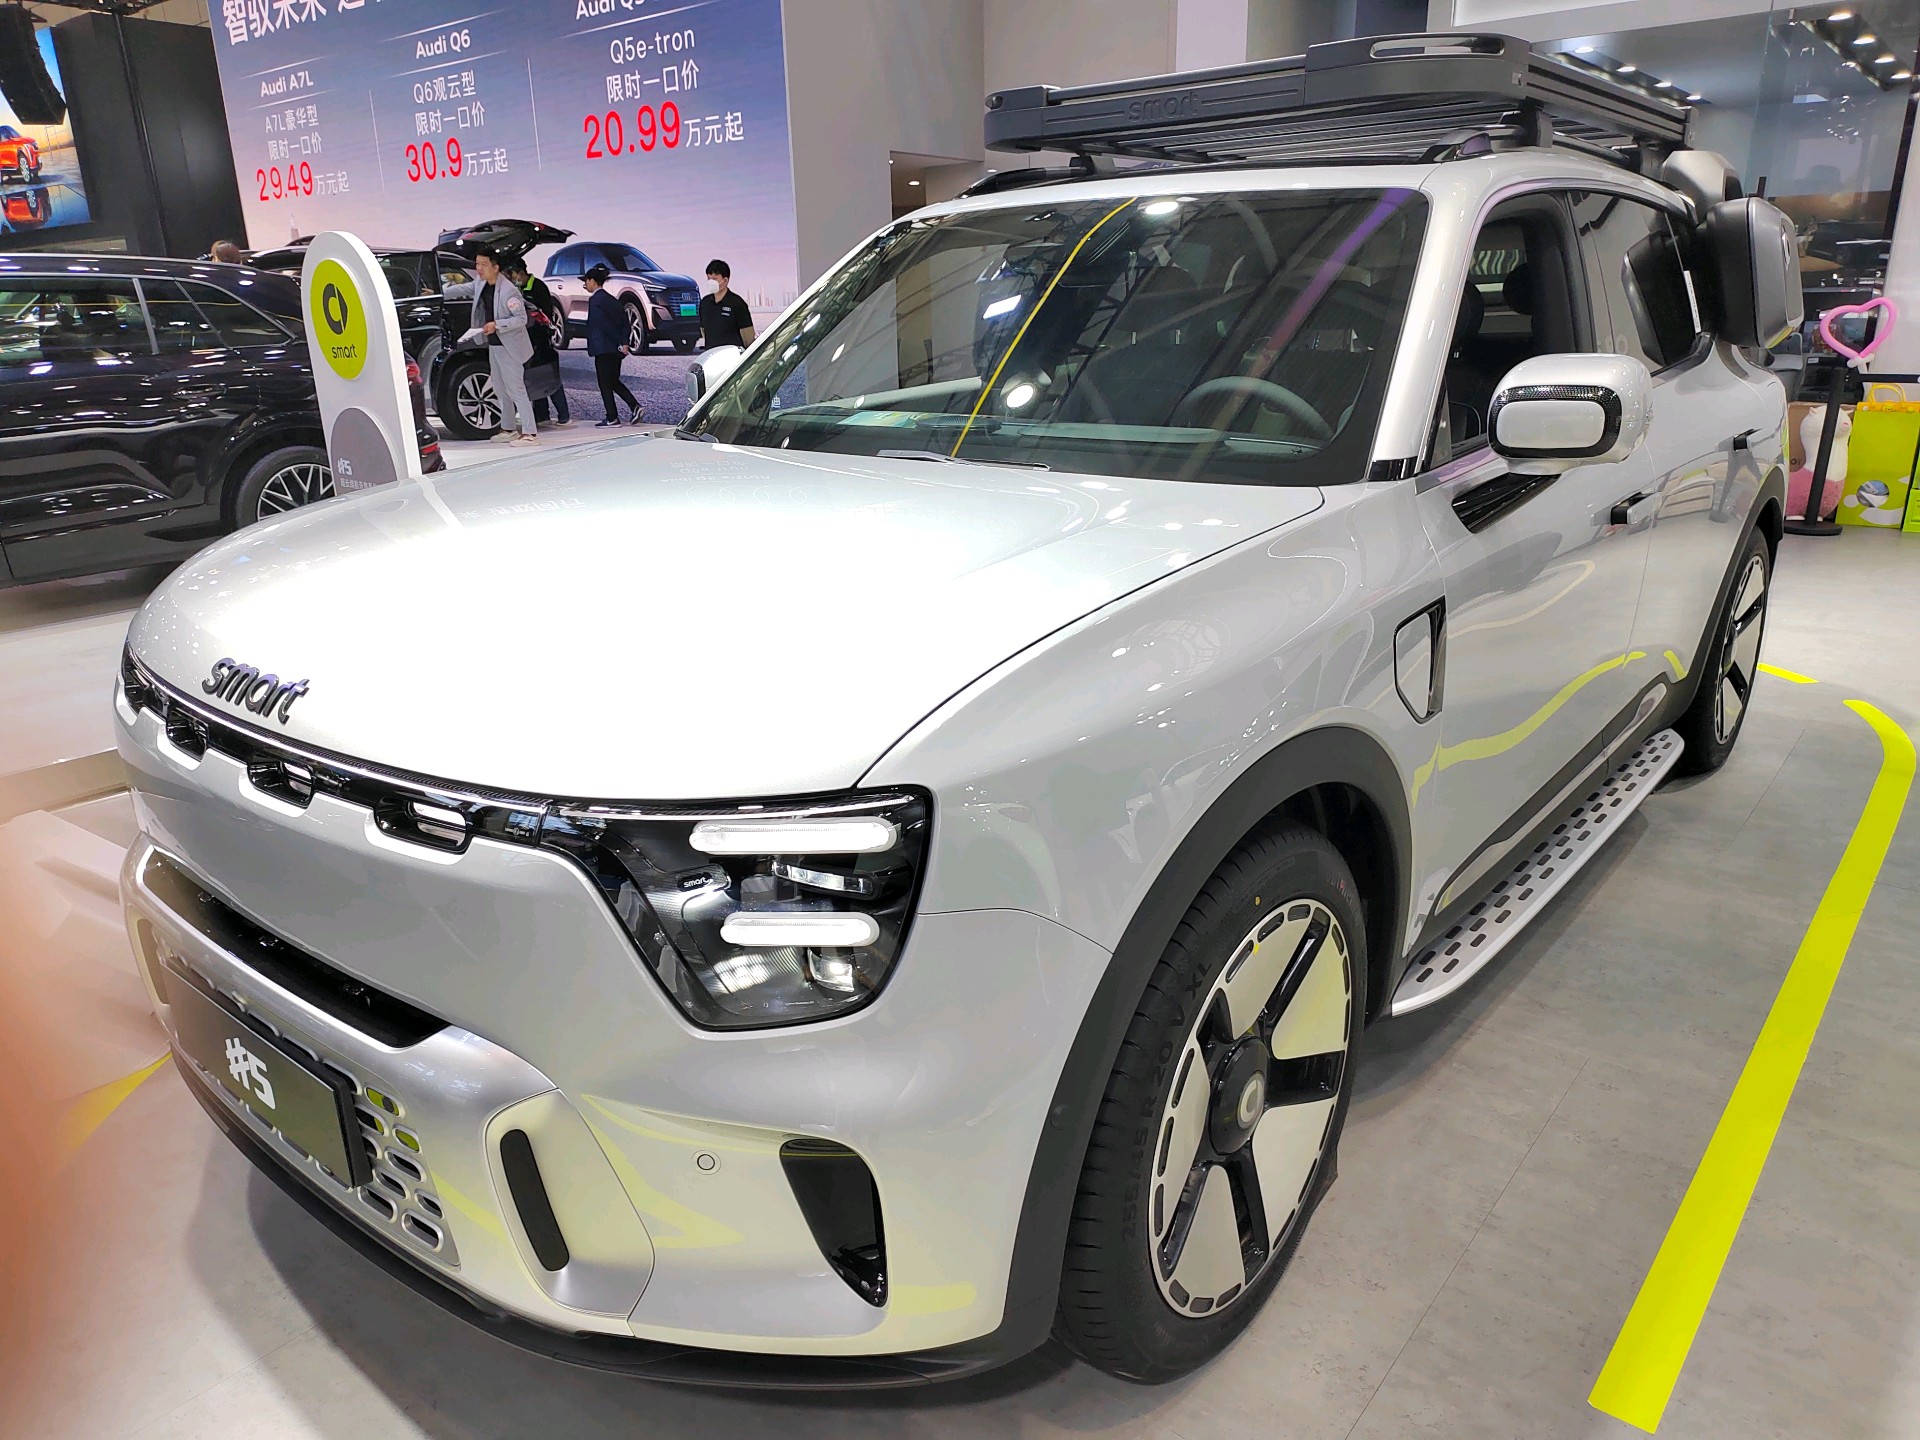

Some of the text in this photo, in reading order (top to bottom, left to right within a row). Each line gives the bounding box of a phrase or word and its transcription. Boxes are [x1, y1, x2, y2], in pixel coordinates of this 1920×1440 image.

[416, 29, 471, 59] Audi Q6
[610, 29, 695, 65] Q5e-tron
[261, 70, 314, 98] Audi A7L
[413, 69, 477, 105] Q6观云型
[606, 59, 700, 104] 限时一口价
[265, 104, 320, 133] A7L豪华型
[415, 101, 486, 137] 限时一口价
[1128, 91, 1199, 123] smart
[267, 131, 322, 161] 限时一口价
[331, 343, 358, 359] smart
[201, 657, 310, 726] smart
[683, 876, 706, 888] smart
[1184, 963, 1212, 1000] XL
[225, 1037, 276, 1110] #5
